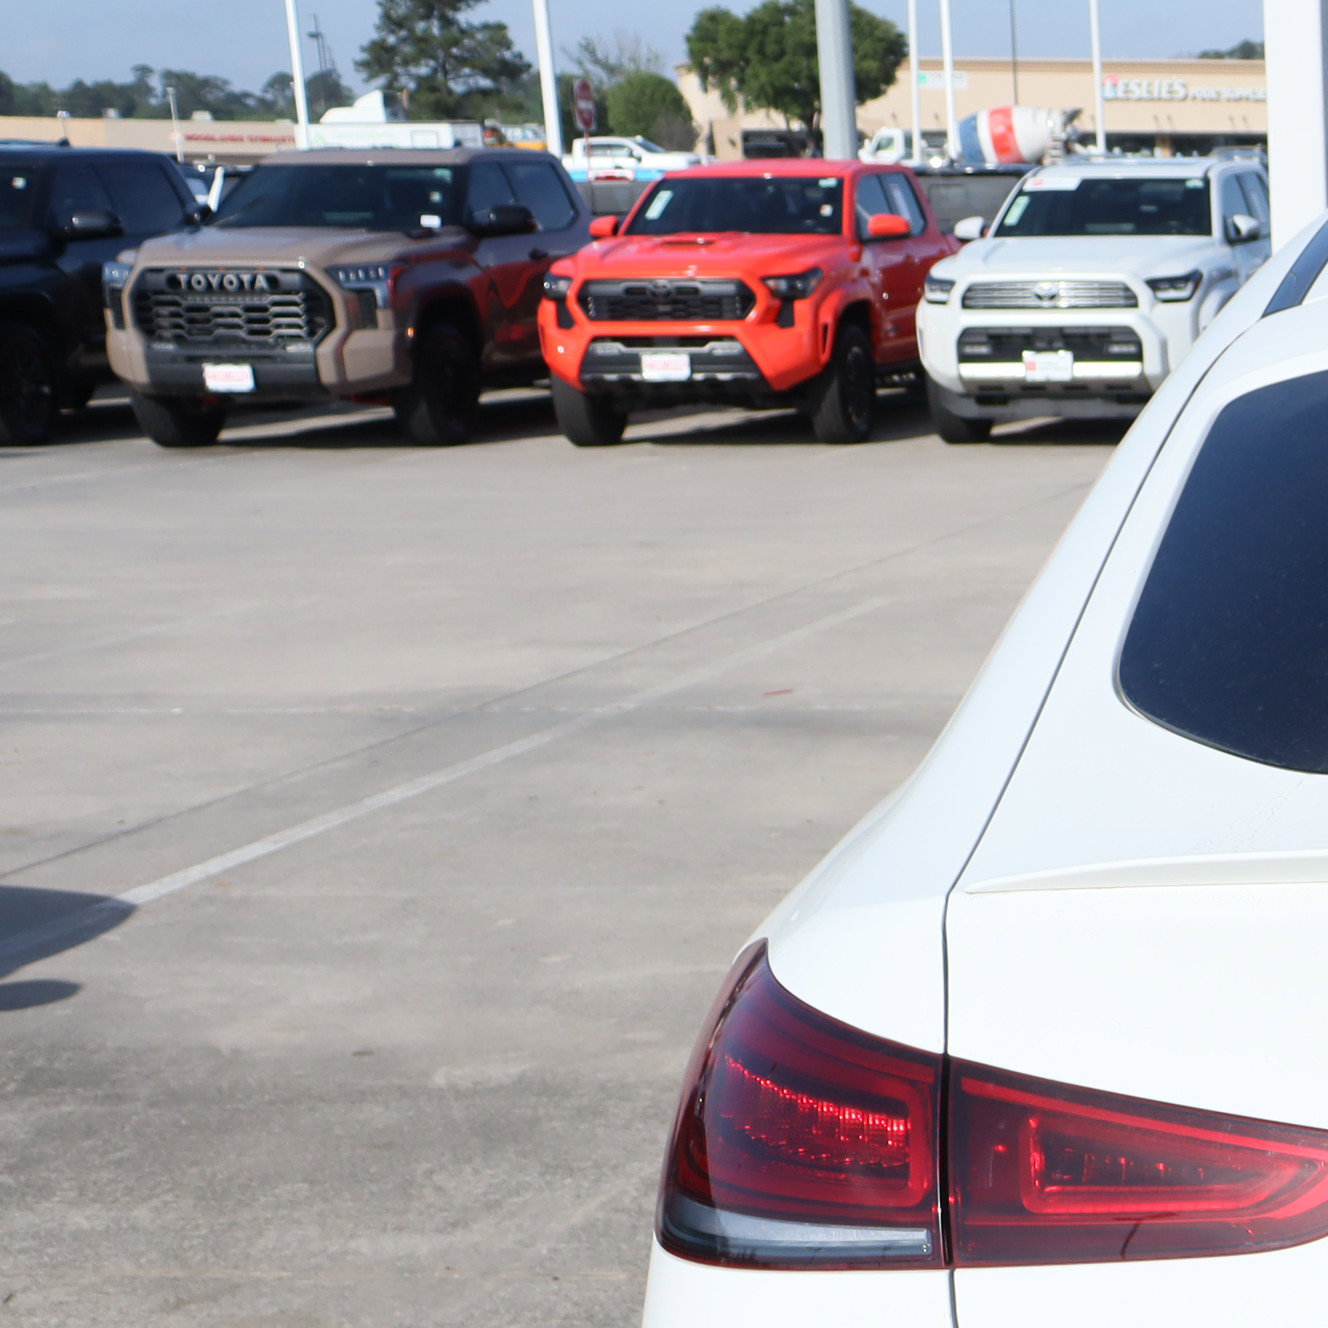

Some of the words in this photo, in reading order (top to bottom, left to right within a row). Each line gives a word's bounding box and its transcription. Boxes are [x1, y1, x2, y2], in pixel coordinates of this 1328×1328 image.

[1102, 77, 1188, 100] LESLIE'S
[1223, 87, 1267, 101] SUPPLIE
[177, 273, 269, 292] TOYOTA
